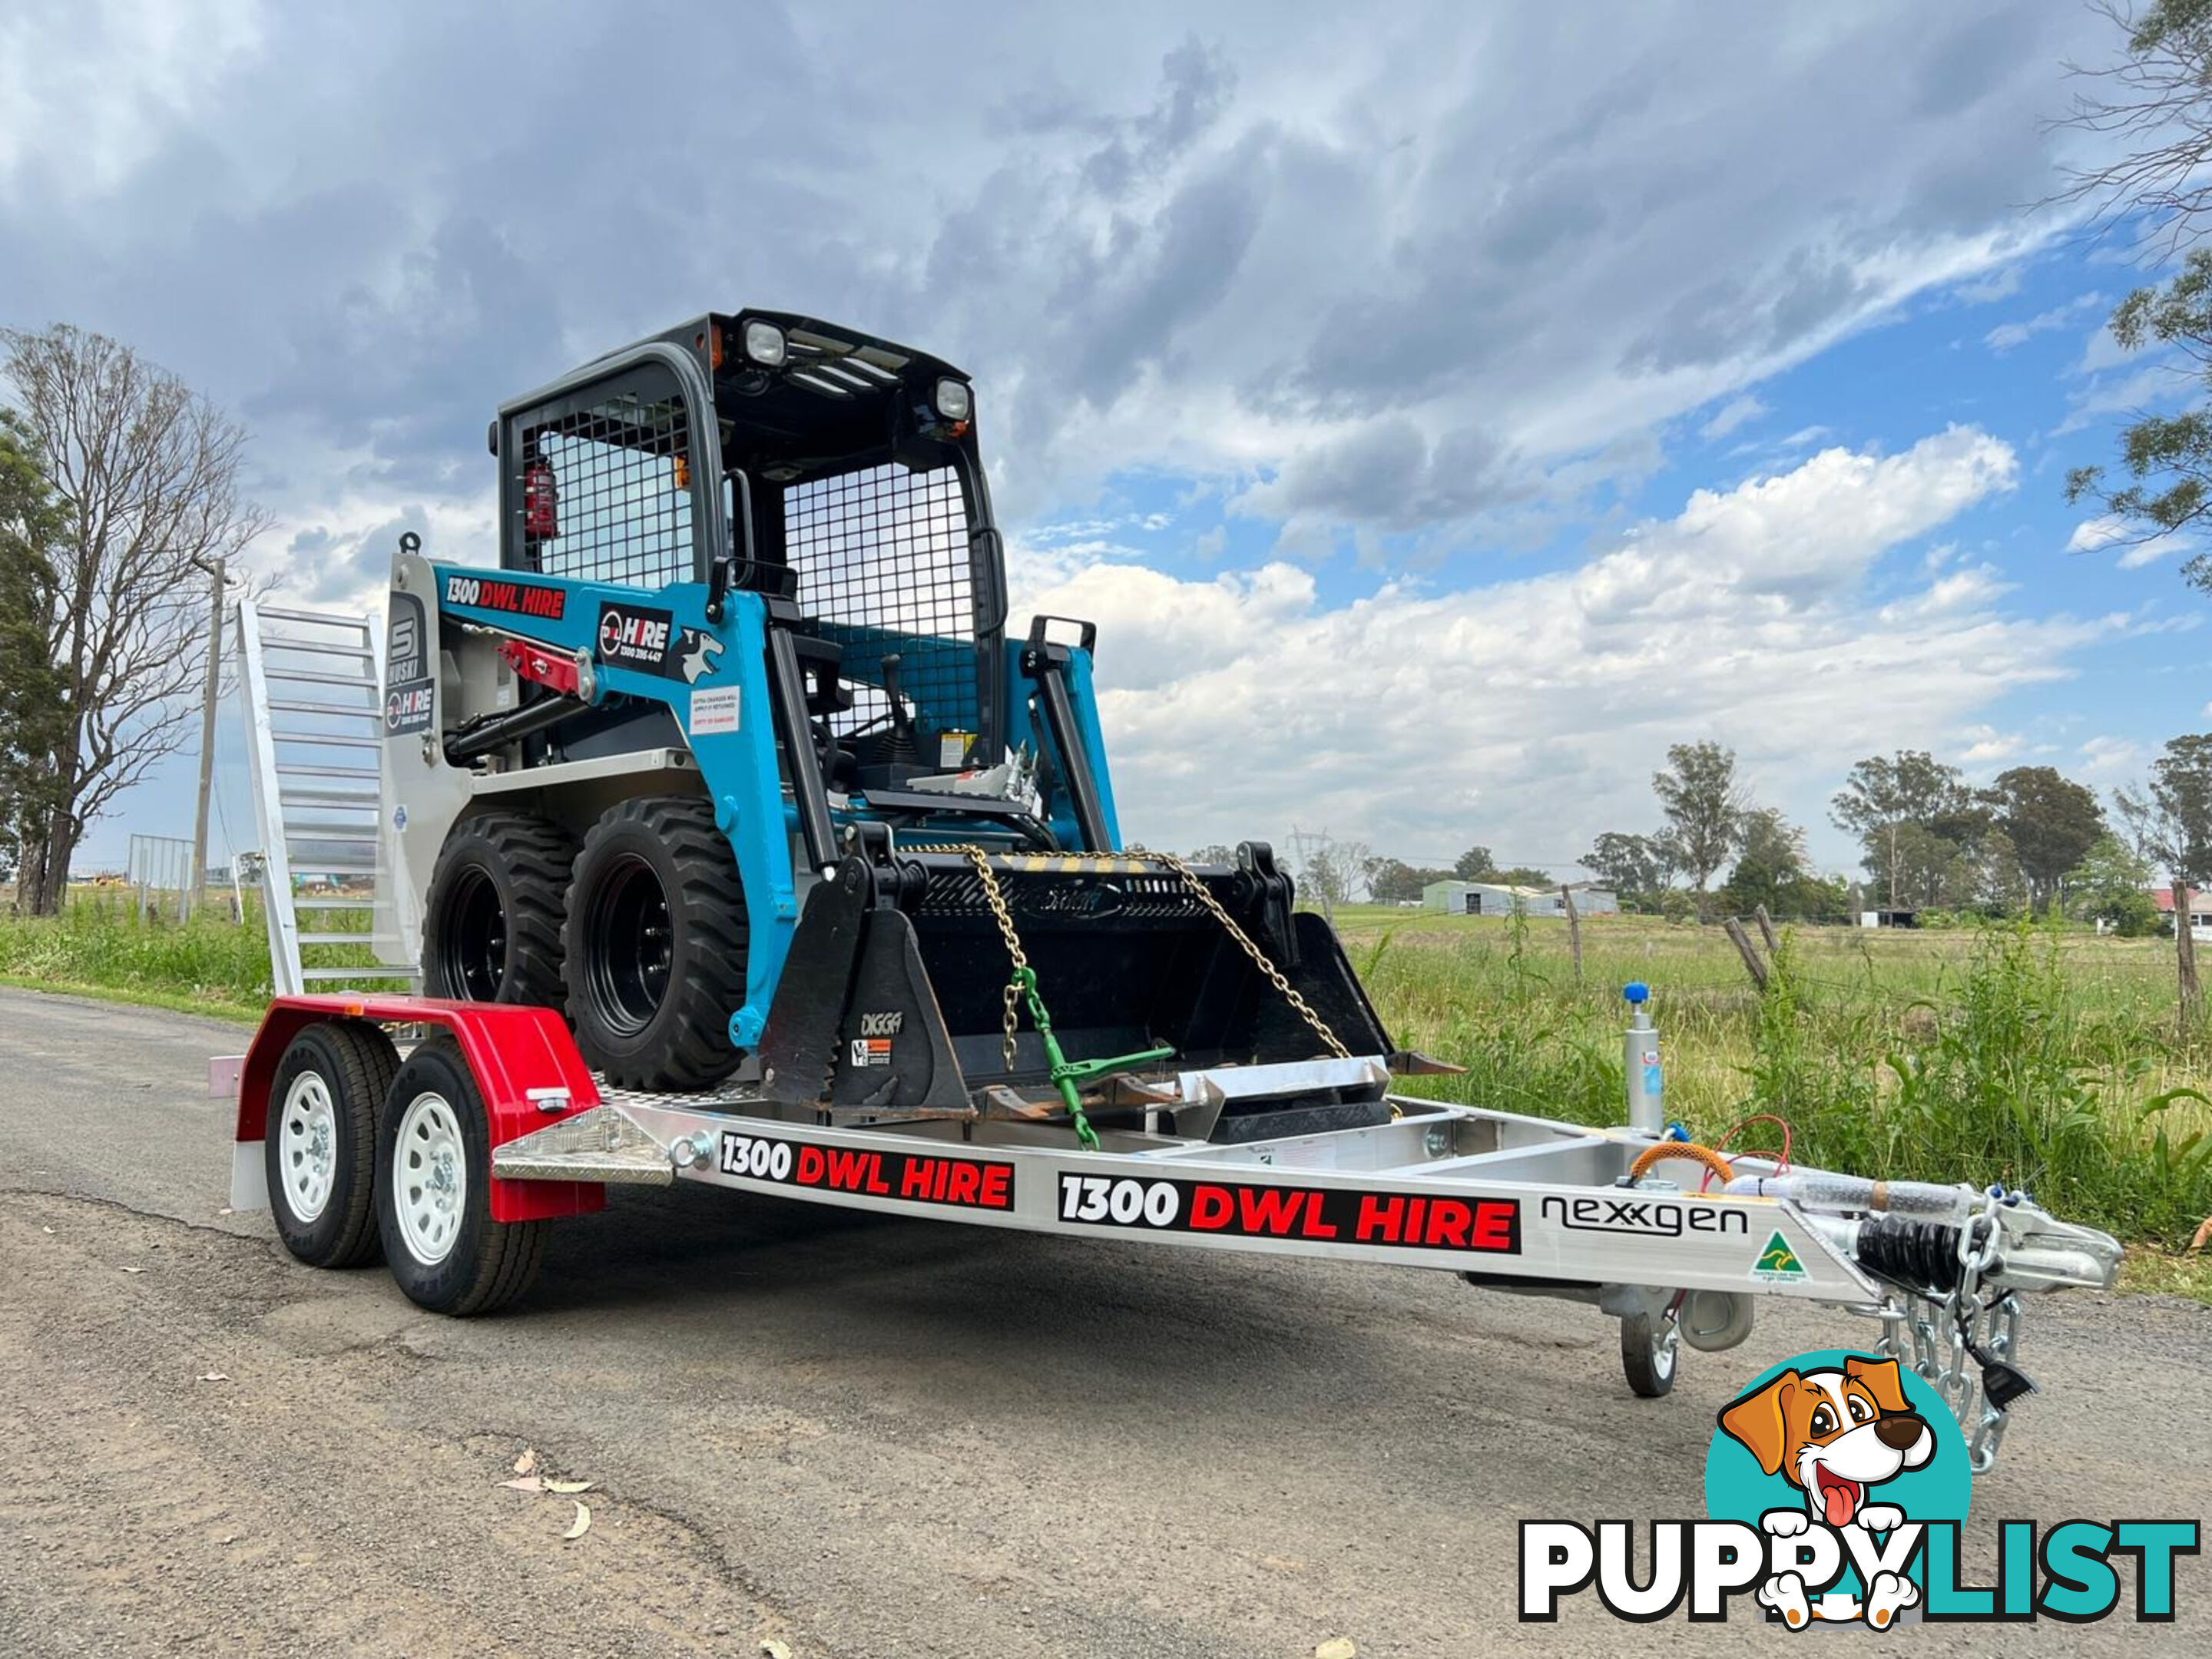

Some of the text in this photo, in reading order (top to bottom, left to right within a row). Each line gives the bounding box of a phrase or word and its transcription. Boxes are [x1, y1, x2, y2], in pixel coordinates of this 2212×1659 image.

[447, 578, 565, 618] 1300 DWL HIRE
[622, 617, 669, 650] HIRE
[388, 659, 419, 685] HUSKI
[402, 688, 432, 714] HIRE
[861, 1011, 902, 1035] DIGGA
[723, 1135, 1011, 1207] 1300 DWL HIRE
[1061, 1176, 1515, 1249] 1300 DWL HIRE
[1541, 1196, 1748, 1237] nexxgen
